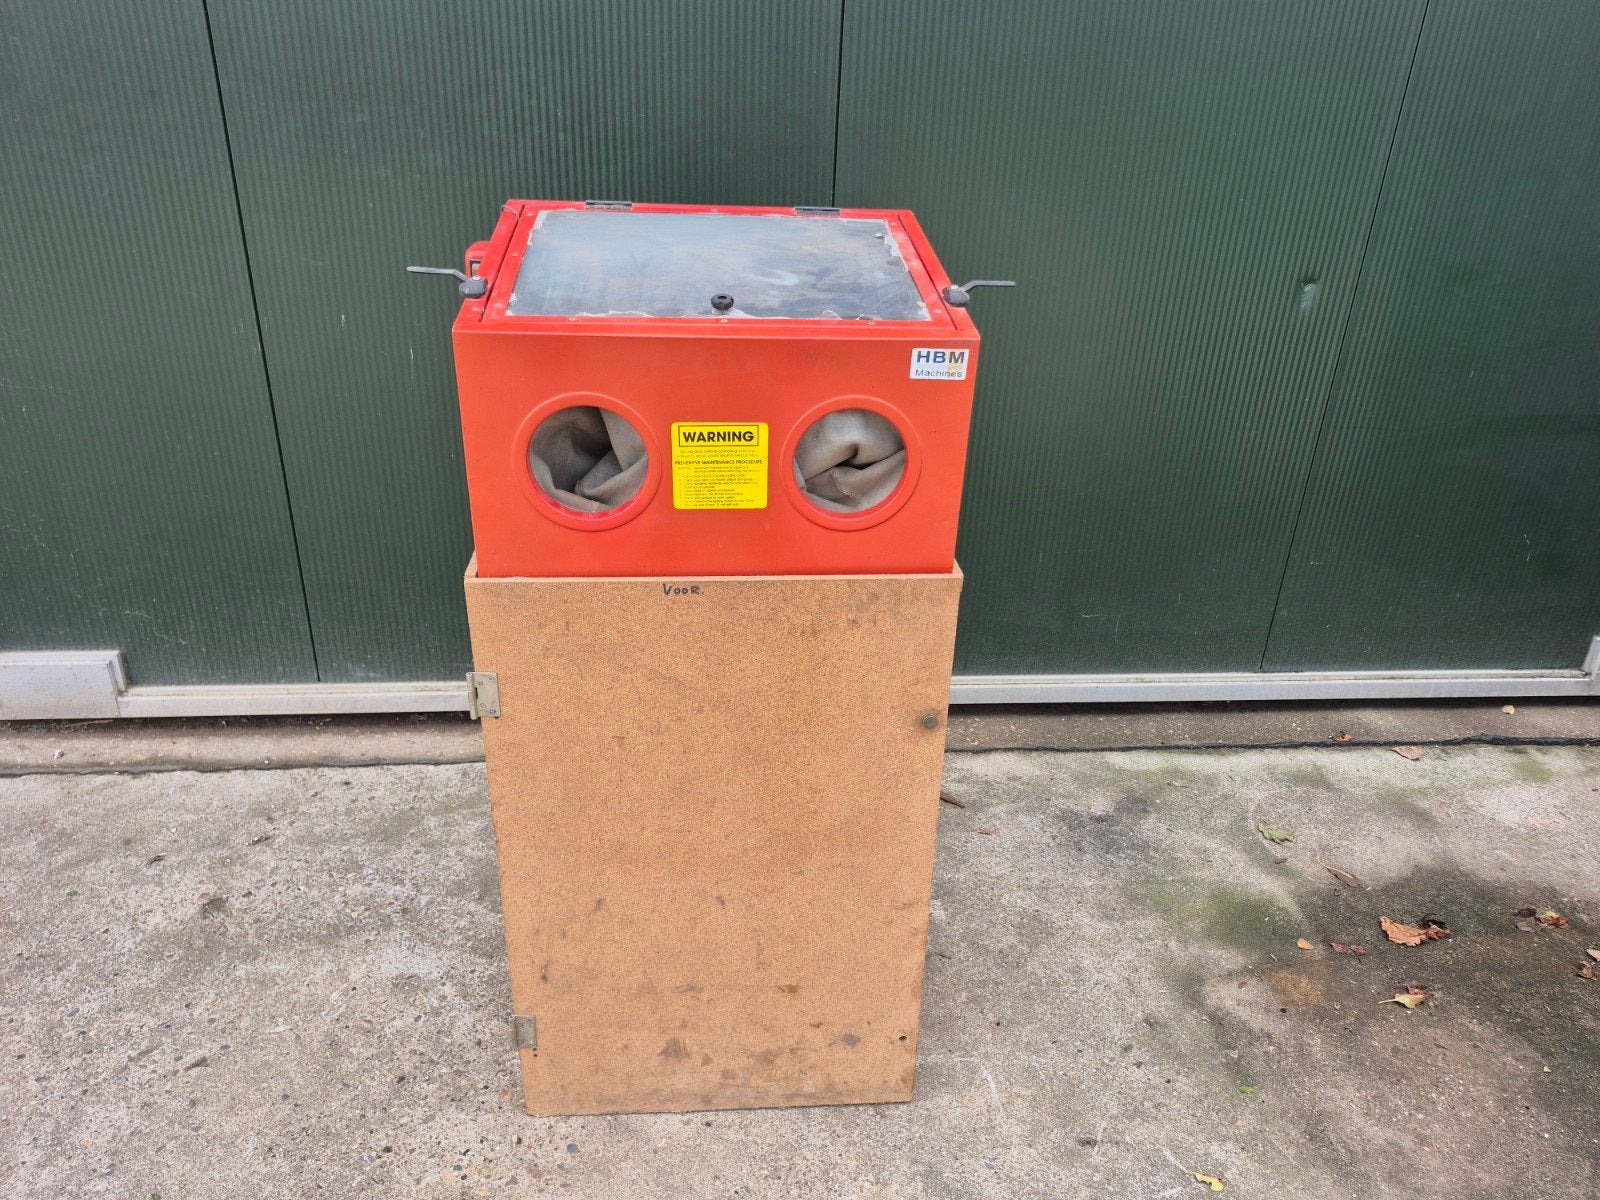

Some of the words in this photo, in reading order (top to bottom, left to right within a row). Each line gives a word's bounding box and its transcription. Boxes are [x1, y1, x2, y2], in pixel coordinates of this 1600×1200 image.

[916, 350, 965, 364] HBM
[915, 369, 963, 378] Machines
[682, 431, 755, 443] WARNING
